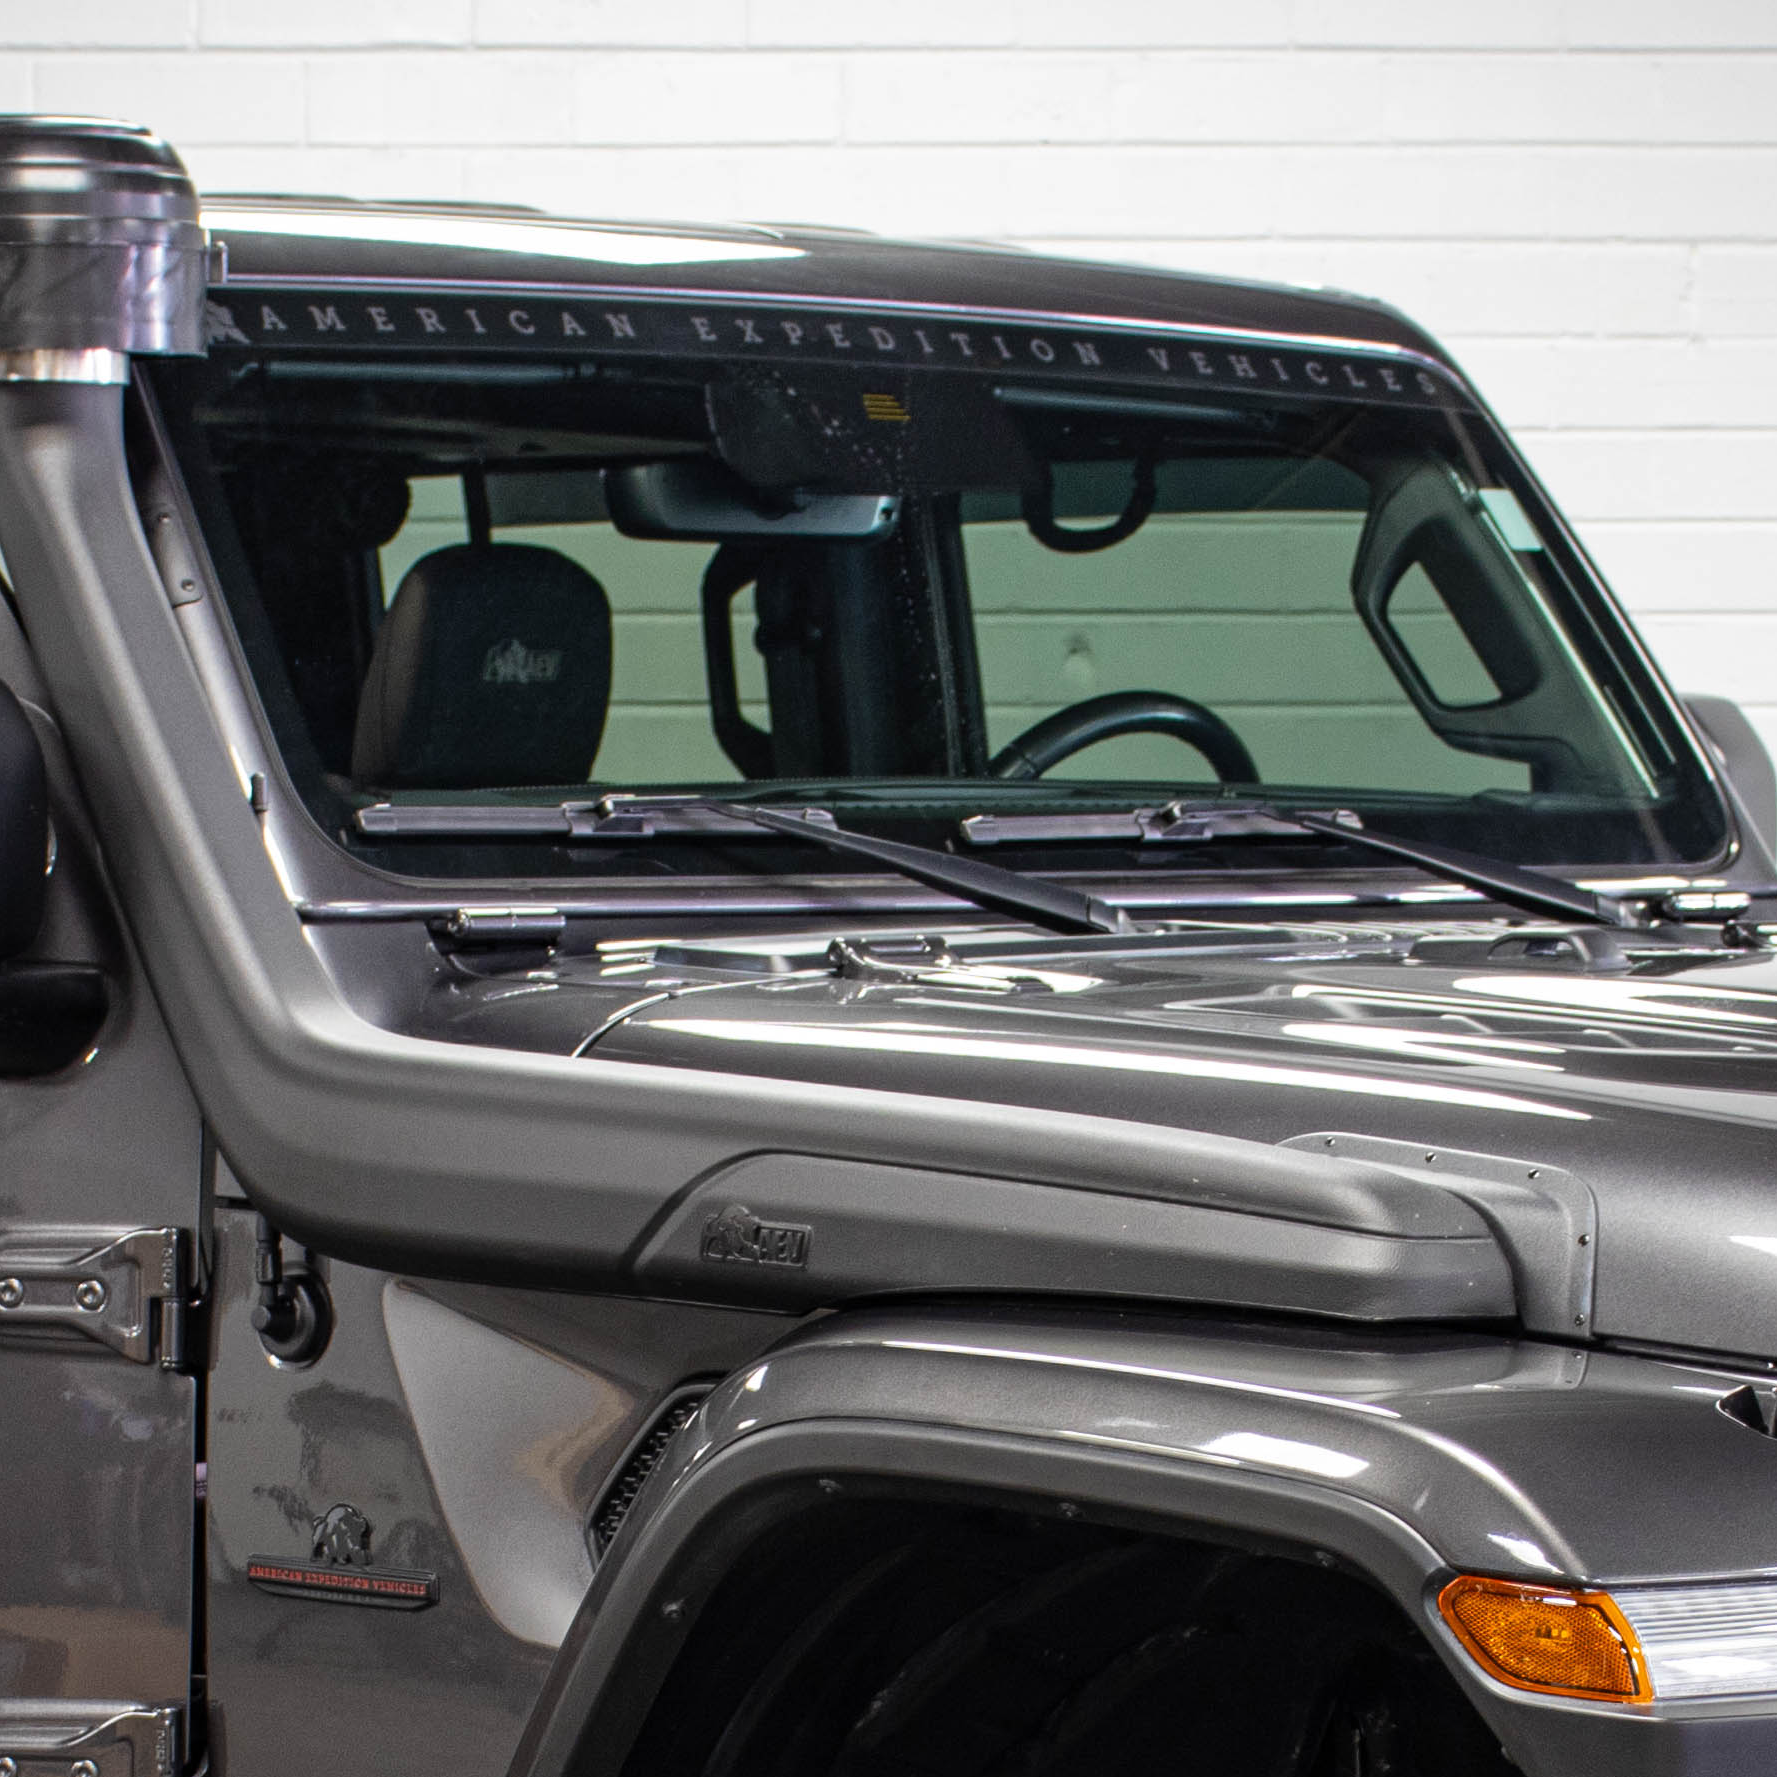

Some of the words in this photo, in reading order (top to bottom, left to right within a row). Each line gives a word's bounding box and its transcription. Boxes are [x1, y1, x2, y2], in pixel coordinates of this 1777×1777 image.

[259, 304, 637, 338] AMERICAN
[690, 315, 1102, 367] EXPEDITION
[1146, 347, 1437, 395] VEHICLES
[249, 1565, 303, 1581] AMERICAN
[305, 1571, 370, 1590] EXPEDITION
[372, 1578, 426, 1596] VEHICLES
